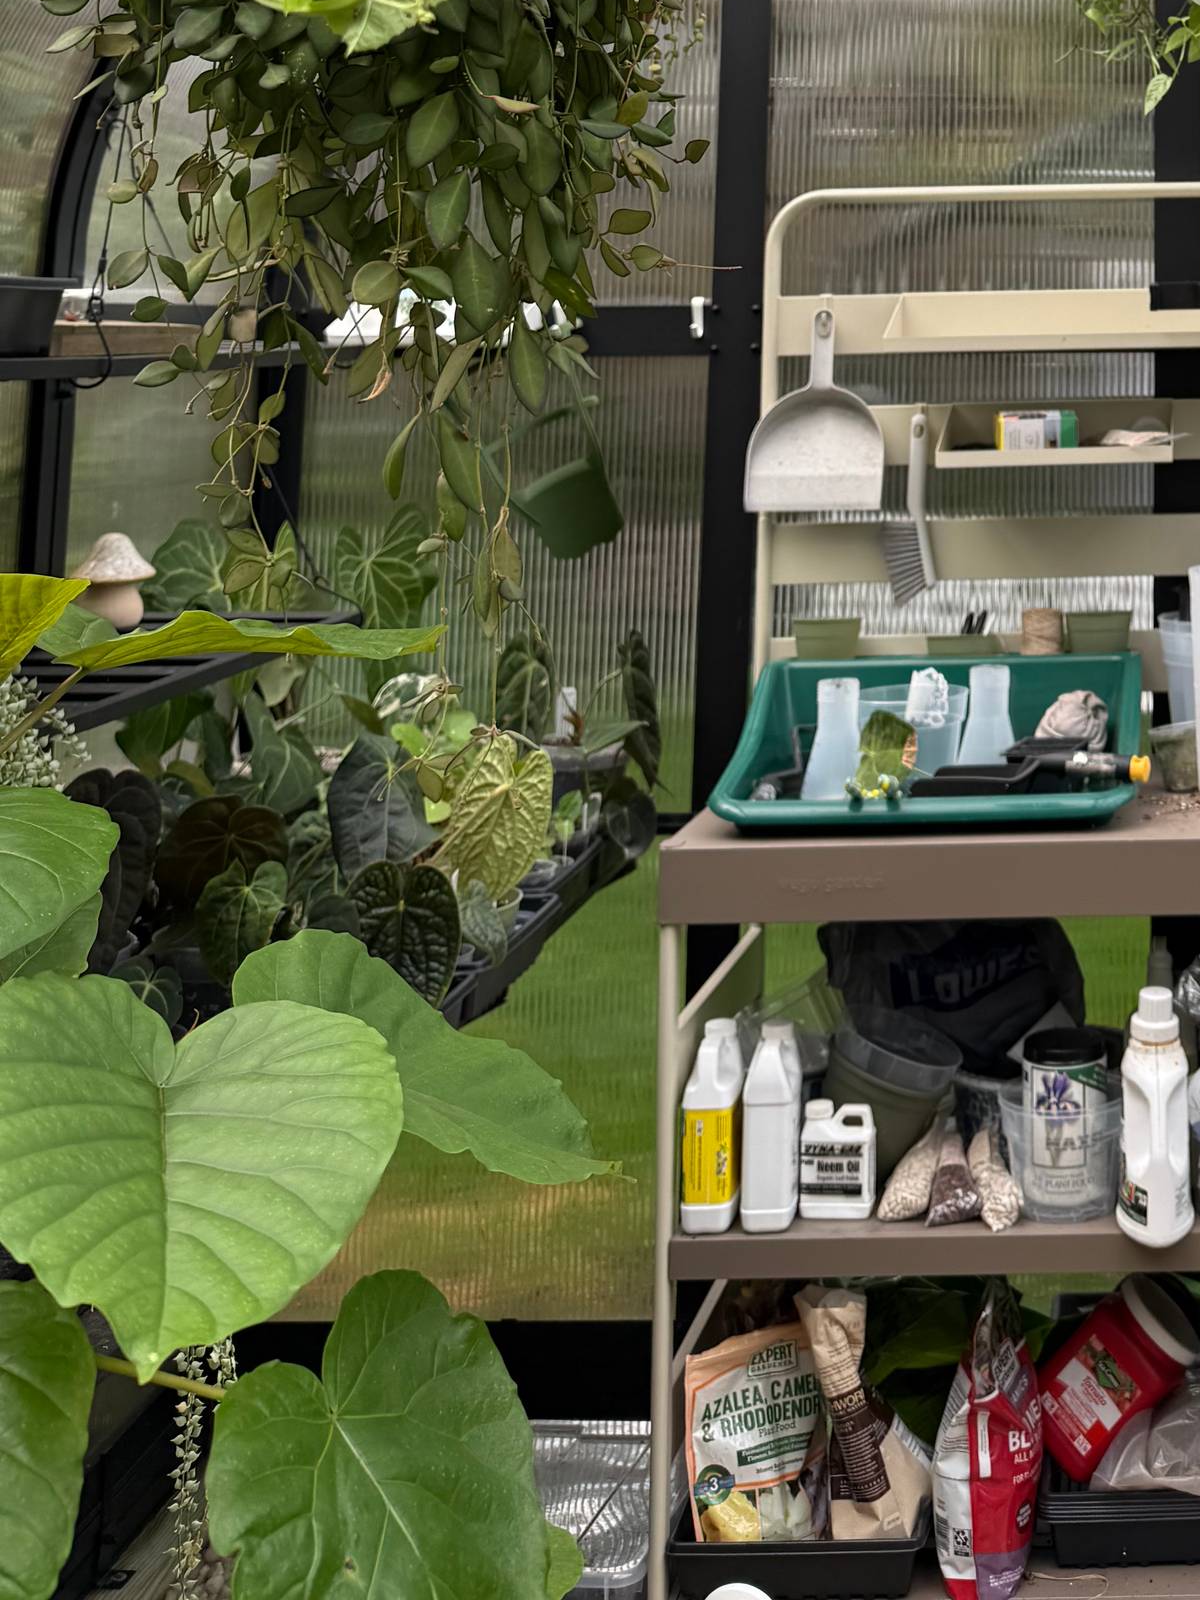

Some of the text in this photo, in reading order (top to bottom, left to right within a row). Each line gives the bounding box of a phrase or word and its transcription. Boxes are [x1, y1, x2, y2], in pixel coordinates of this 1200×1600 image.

[817, 1160, 844, 1173] Neem
[847, 1160, 861, 1173] Oil
[751, 1343, 793, 1365] EXPERT
[702, 1385, 768, 1422] AZALEA,
[702, 1422, 715, 1443] &
[708, 1476, 719, 1492] 3
